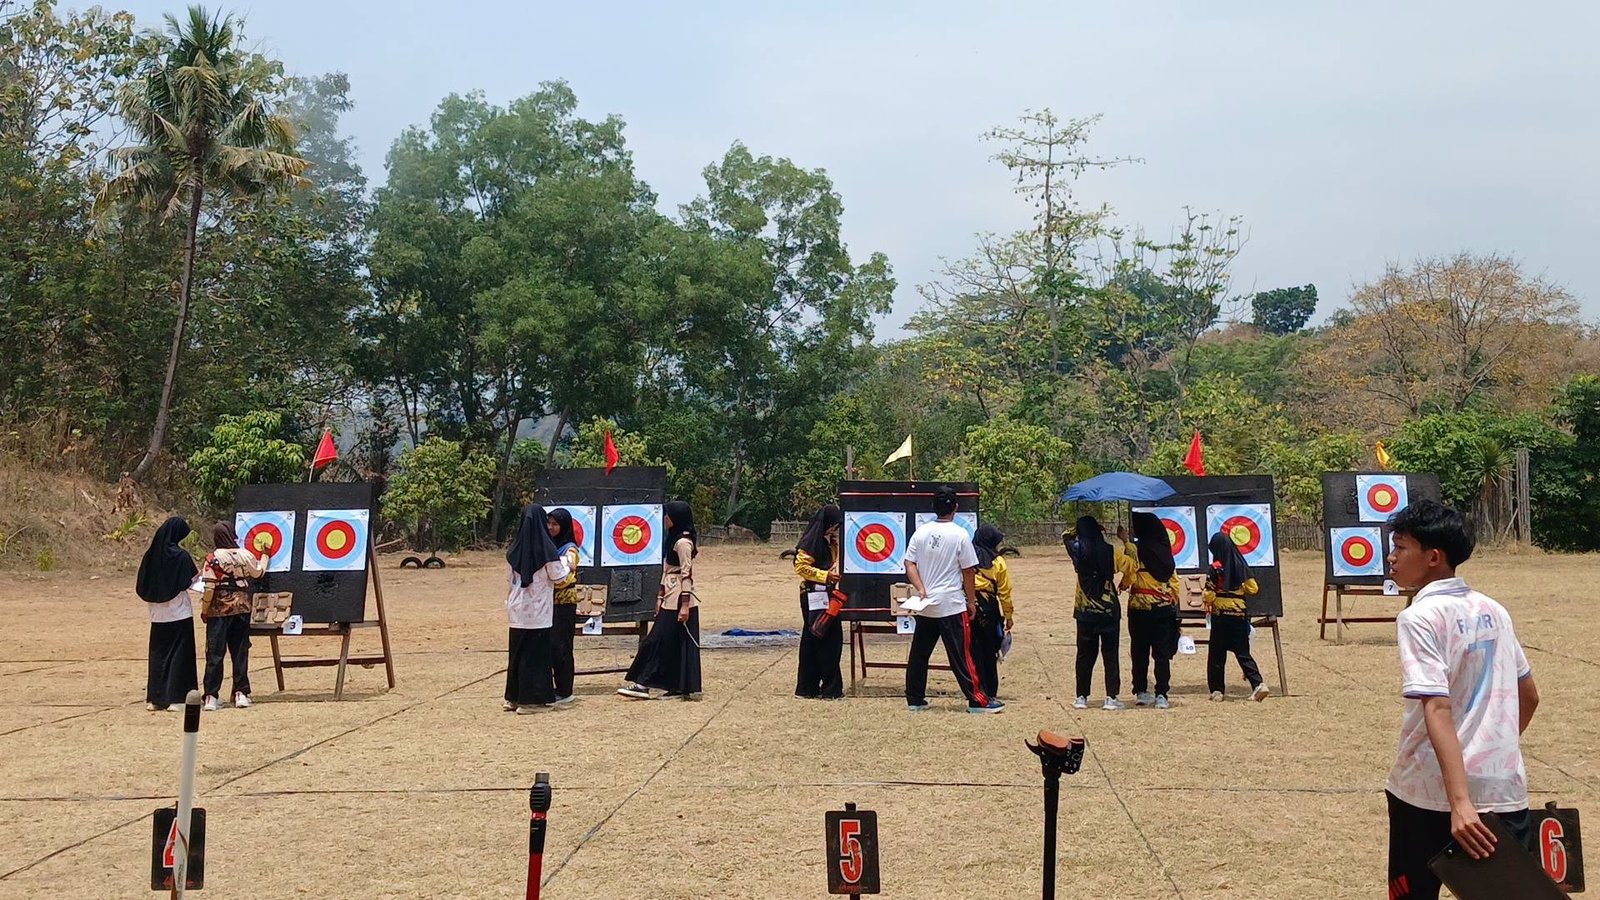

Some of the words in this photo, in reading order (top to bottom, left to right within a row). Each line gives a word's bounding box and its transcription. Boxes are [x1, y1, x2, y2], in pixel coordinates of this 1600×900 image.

[289, 621, 296, 630] 3
[903, 620, 909, 630] 5
[1464, 639, 1496, 715] 7
[839, 819, 863, 884] 5
[1539, 817, 1567, 884] 6
